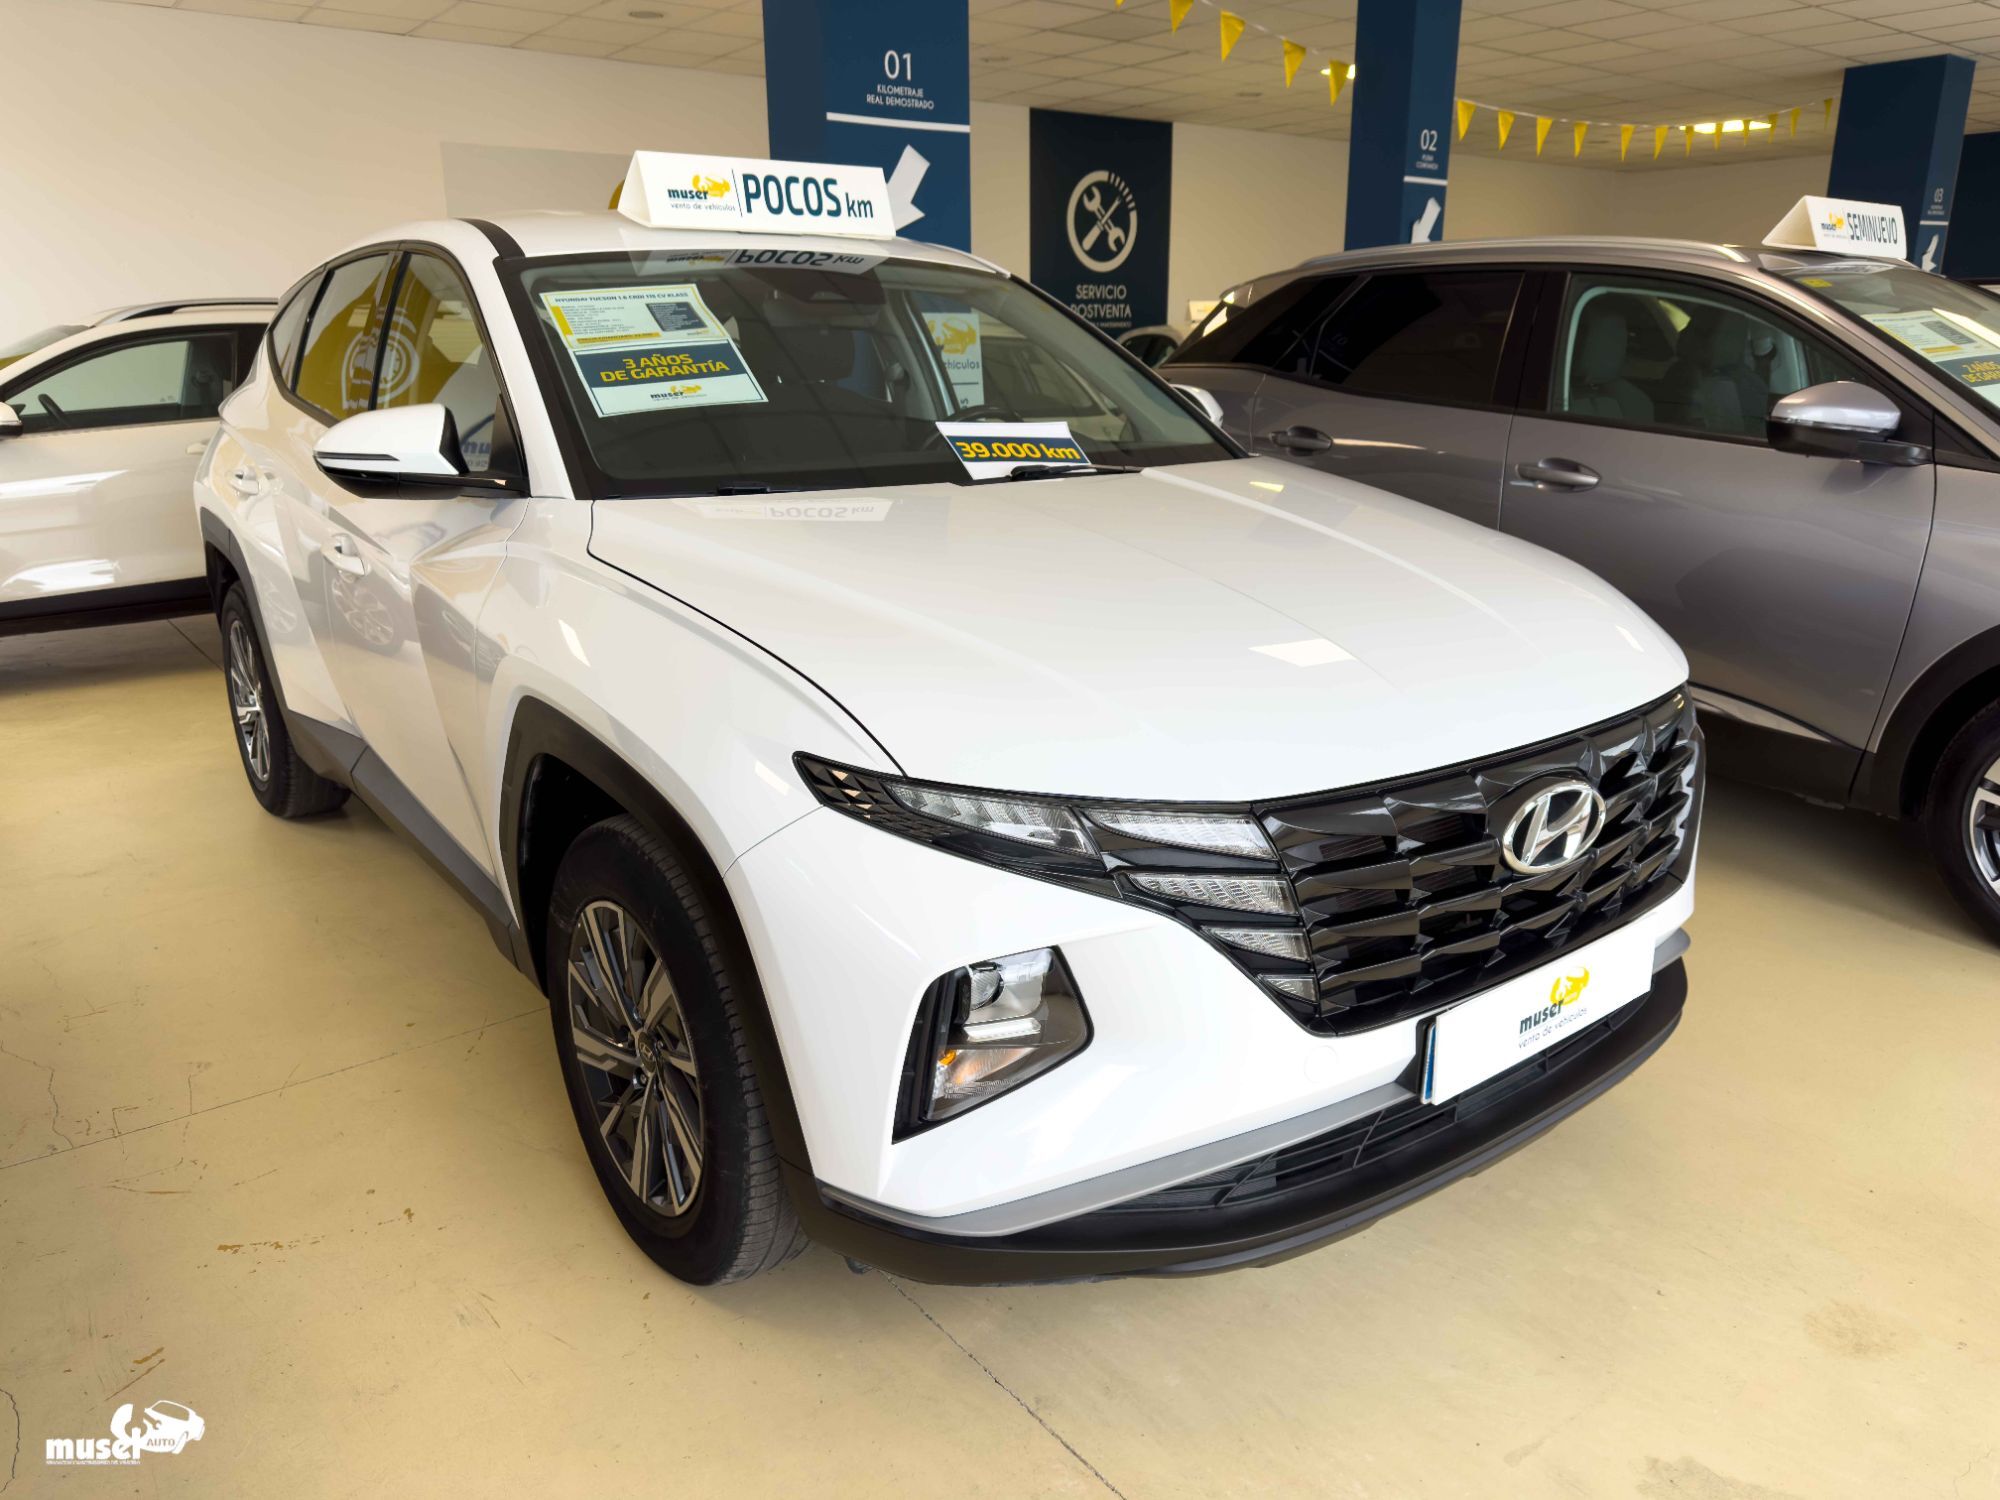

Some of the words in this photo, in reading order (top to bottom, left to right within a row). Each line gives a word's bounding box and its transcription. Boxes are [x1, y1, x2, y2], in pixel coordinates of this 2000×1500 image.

[884, 50, 912, 81] 01
[877, 84, 924, 98] KILOMETRAJE
[866, 94, 884, 105] REAL
[885, 96, 935, 110] DEMOSTRADO
[1420, 129, 1438, 151] 02
[667, 188, 709, 200] muser
[742, 173, 842, 218] POCOS
[845, 192, 874, 218] km
[1846, 212, 1898, 245] SEMINUEVO
[1075, 284, 1127, 300] SERVICIO
[1070, 303, 1132, 320] POSTVENTA
[622, 358, 637, 370] 3
[639, 353, 693, 368] AÑOS
[600, 370, 629, 383] DE
[630, 359, 730, 380] GARANTÍA
[649, 391, 685, 400] muser
[955, 441, 1041, 459] 39.000
[1039, 443, 1081, 460] km
[1519, 998, 1565, 1035] muser
[1542, 1025, 1553, 1037] de
